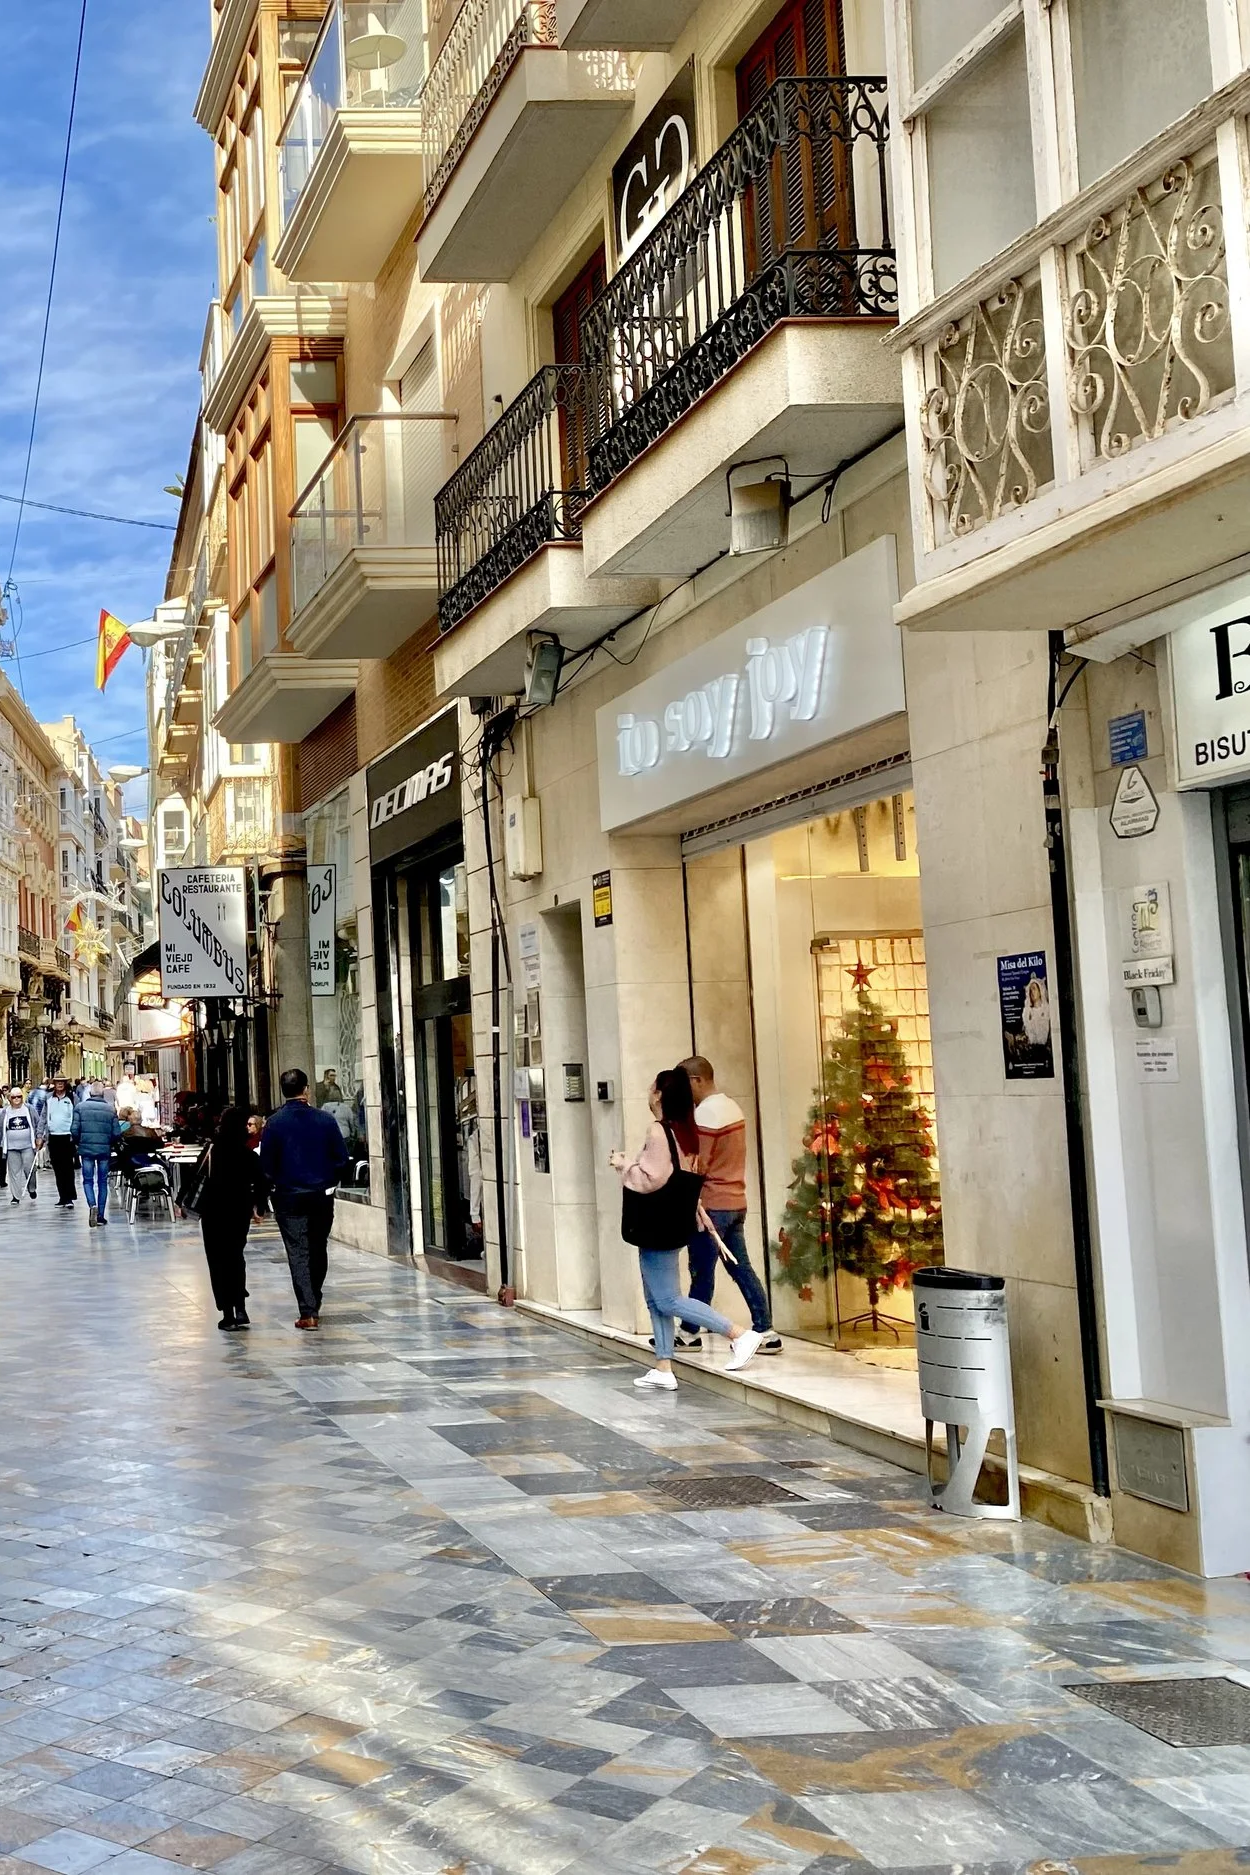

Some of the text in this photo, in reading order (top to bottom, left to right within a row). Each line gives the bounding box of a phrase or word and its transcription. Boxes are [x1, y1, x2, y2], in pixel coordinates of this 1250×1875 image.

[616, 625, 831, 776] io soy joy
[1195, 729, 1250, 766] BISU
[370, 751, 454, 830] DECIMAS
[187, 874, 236, 884] CAFETERIA
[182, 884, 242, 894] RESTAURANTE
[161, 873, 245, 994] COLUMBUS
[165, 943, 176, 953] MI
[166, 953, 193, 963] VIEJO
[1000, 955, 1043, 970] Misa del Kilo
[166, 964, 190, 974] CAFE
[1123, 968, 1166, 980] Black Friday
